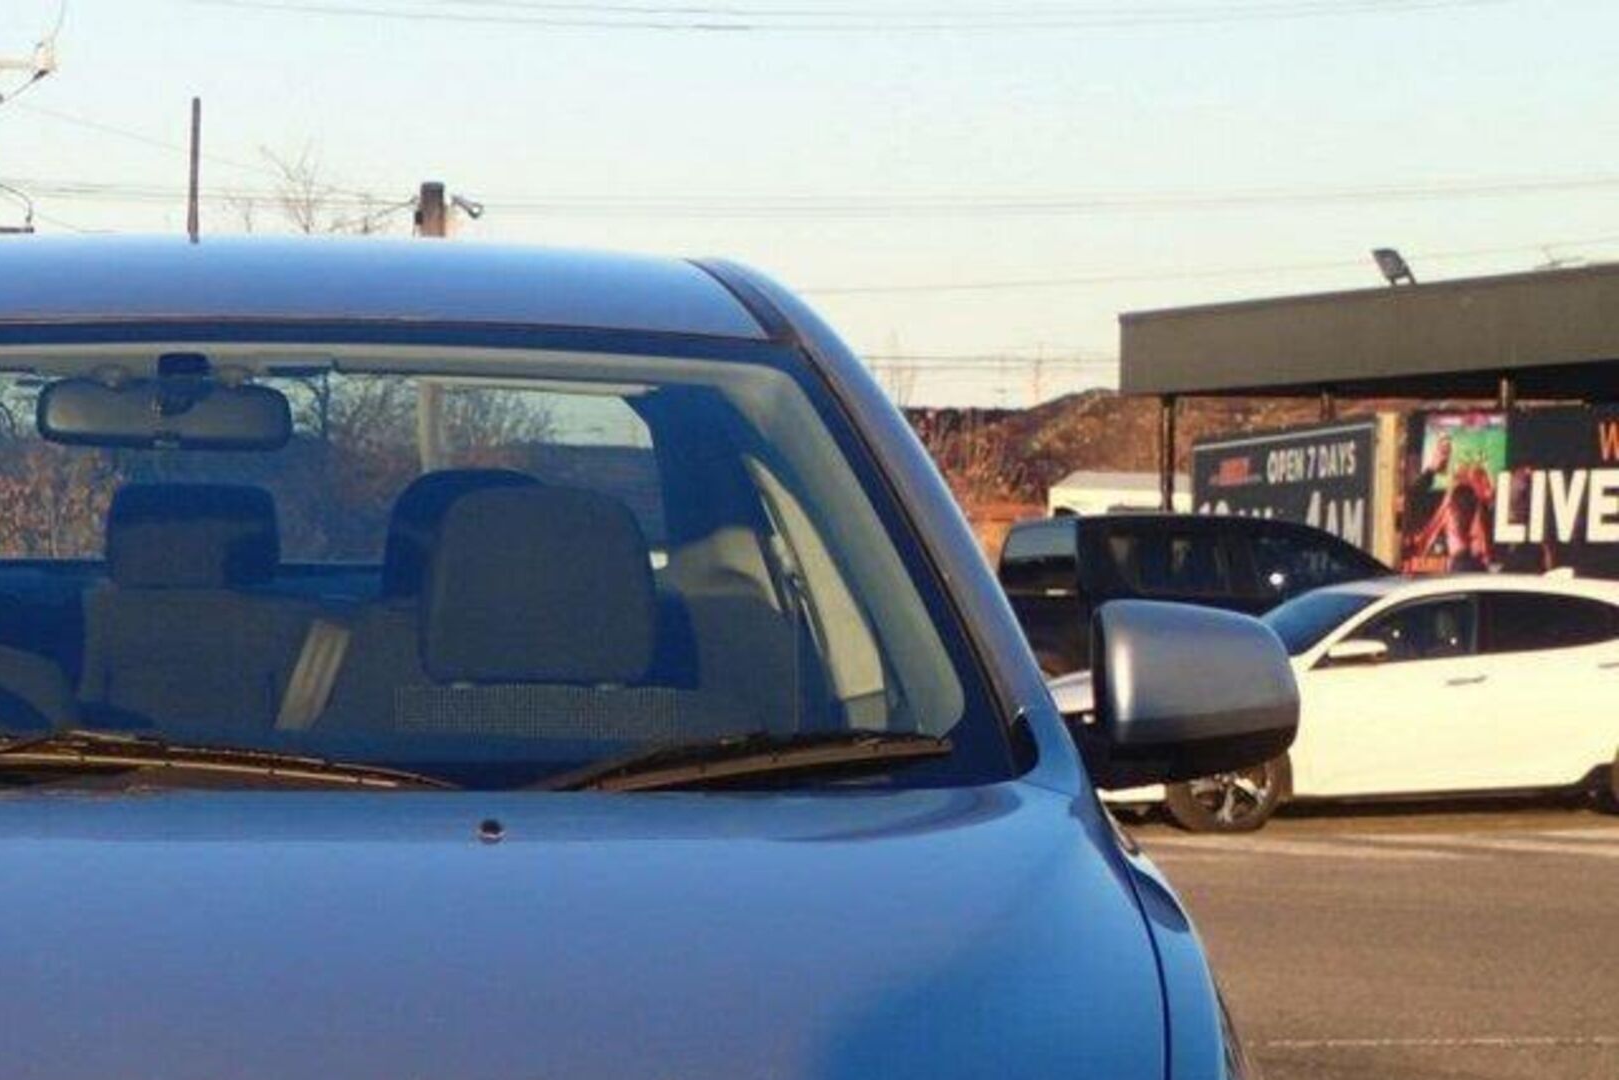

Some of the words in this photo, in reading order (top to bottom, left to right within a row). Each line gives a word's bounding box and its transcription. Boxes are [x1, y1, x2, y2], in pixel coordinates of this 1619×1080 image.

[1266, 448, 1305, 485] OPEN
[1306, 446, 1317, 480] 7
[1318, 440, 1356, 479] DAYS
[1494, 468, 1619, 543] LIVE
